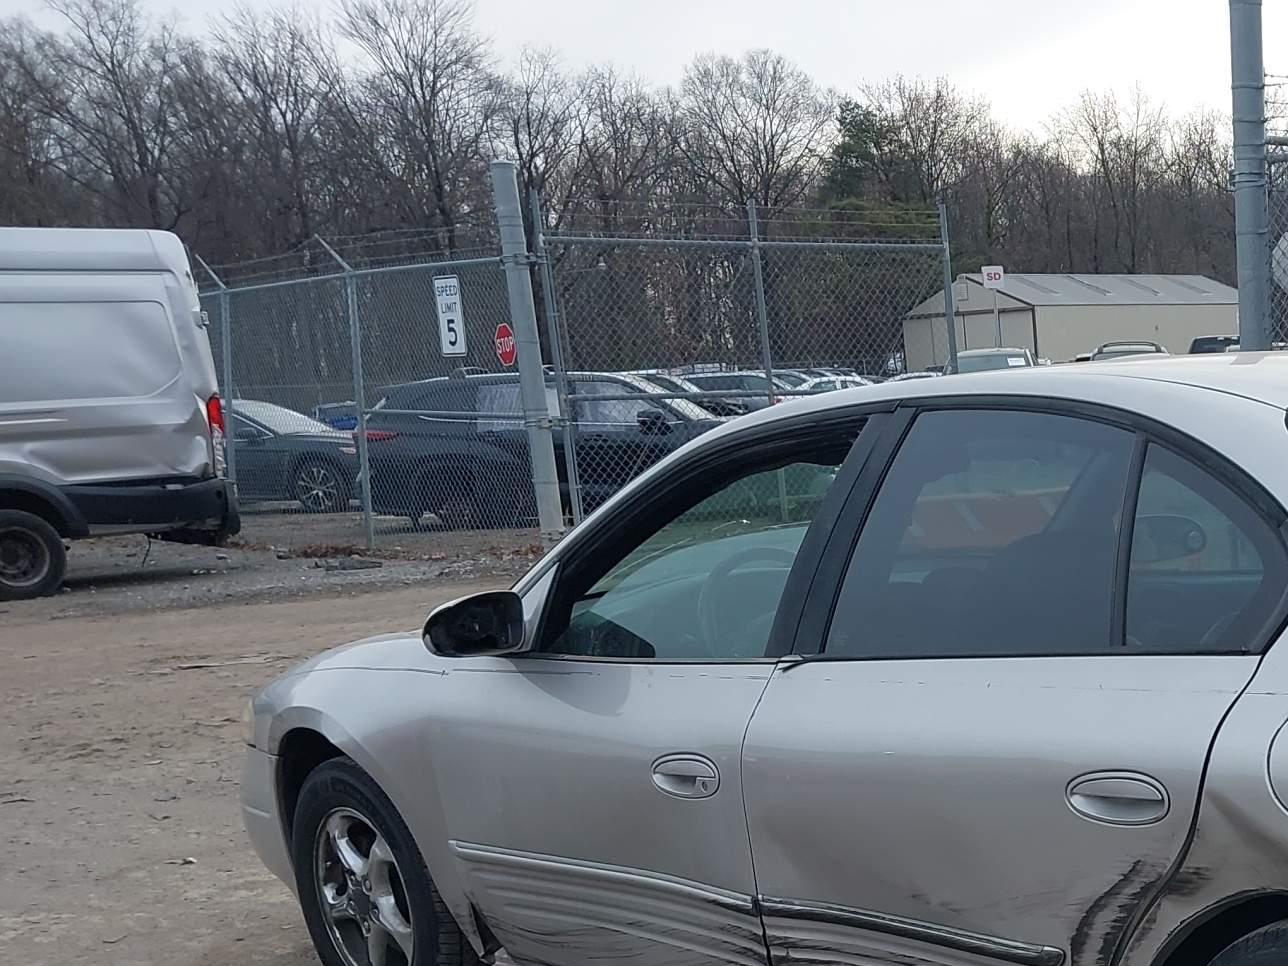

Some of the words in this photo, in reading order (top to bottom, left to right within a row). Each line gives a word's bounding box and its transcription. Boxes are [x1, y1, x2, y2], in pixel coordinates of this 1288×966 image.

[986, 271, 1002, 282] SD
[436, 284, 458, 297] SPEED
[441, 302, 457, 314] LIMIT
[446, 318, 458, 347] 5
[496, 336, 514, 354] STOP
